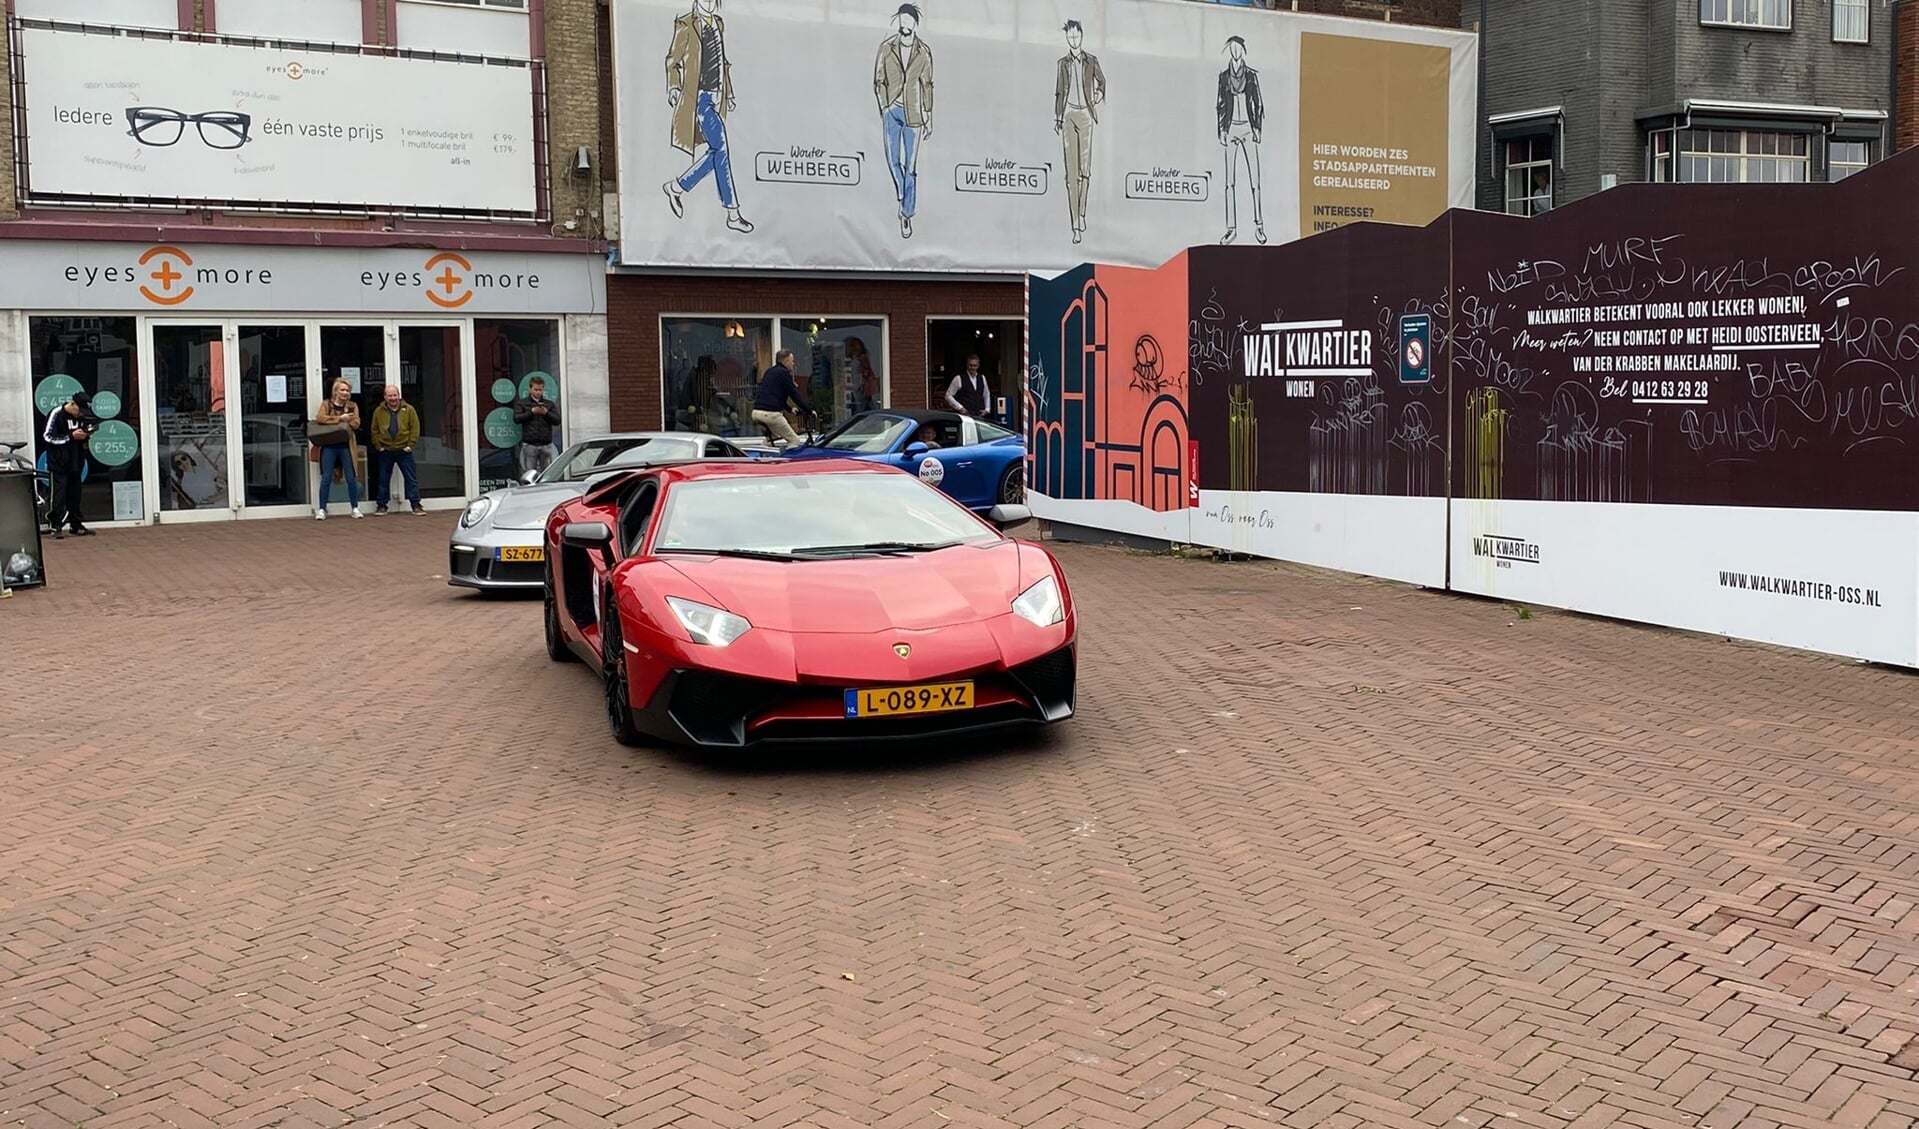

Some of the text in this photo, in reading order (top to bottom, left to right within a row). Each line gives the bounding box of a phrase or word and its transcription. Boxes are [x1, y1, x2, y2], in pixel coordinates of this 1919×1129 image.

[266, 65, 287, 74] eyes
[54, 105, 384, 143] Iedere één vaste prijs
[407, 129, 459, 140] enkelvoudige
[460, 132, 473, 140] bril
[407, 140, 451, 150] multifocale
[452, 142, 466, 150] bril
[790, 145, 826, 158] Wouter
[1313, 143, 1408, 160] HIER WORDEN ZES
[450, 157, 471, 165] all-in
[985, 158, 1017, 170] Wouter
[1313, 159, 1436, 177] STADSAPPARTEMENTEN
[767, 159, 850, 178] WEHBERG
[1152, 166, 1181, 178] Wouter
[965, 171, 1038, 188] WEHBERG
[1313, 176, 1391, 190] GEREALISEERD
[1134, 179, 1200, 195] WEHBERG
[1313, 205, 1375, 218] INTERESSE?
[65, 266, 272, 287] eyes more
[360, 271, 540, 291] eyes more
[1528, 296, 1805, 325] WALKWARTIER BETEKENT VOORAL OOK LEKKER WONEN!
[1594, 330, 1620, 347] NEEM
[1623, 329, 1667, 346] CONTACT
[1670, 328, 1684, 345] OP
[1687, 327, 1709, 344] MET
[1712, 326, 1742, 344] HEIDI
[1573, 353, 1741, 372] VAN DER KRABBEN MAKELAARDIJ.
[55, 379, 63, 389] 4
[1285, 380, 1315, 398] WONEN
[1599, 376, 1708, 398] Bel 0412 63 29 28
[40, 397, 48, 407] €
[109, 424, 116, 434] 4
[95, 442, 104, 454] €
[505, 548, 543, 560] SZ-677
[1496, 560, 1512, 569] WONEN
[1719, 570, 1882, 608] WWW.WALKWARTIER-OSS.NL
[867, 686, 966, 713] L-089-XZ
[847, 706, 857, 714] NL
